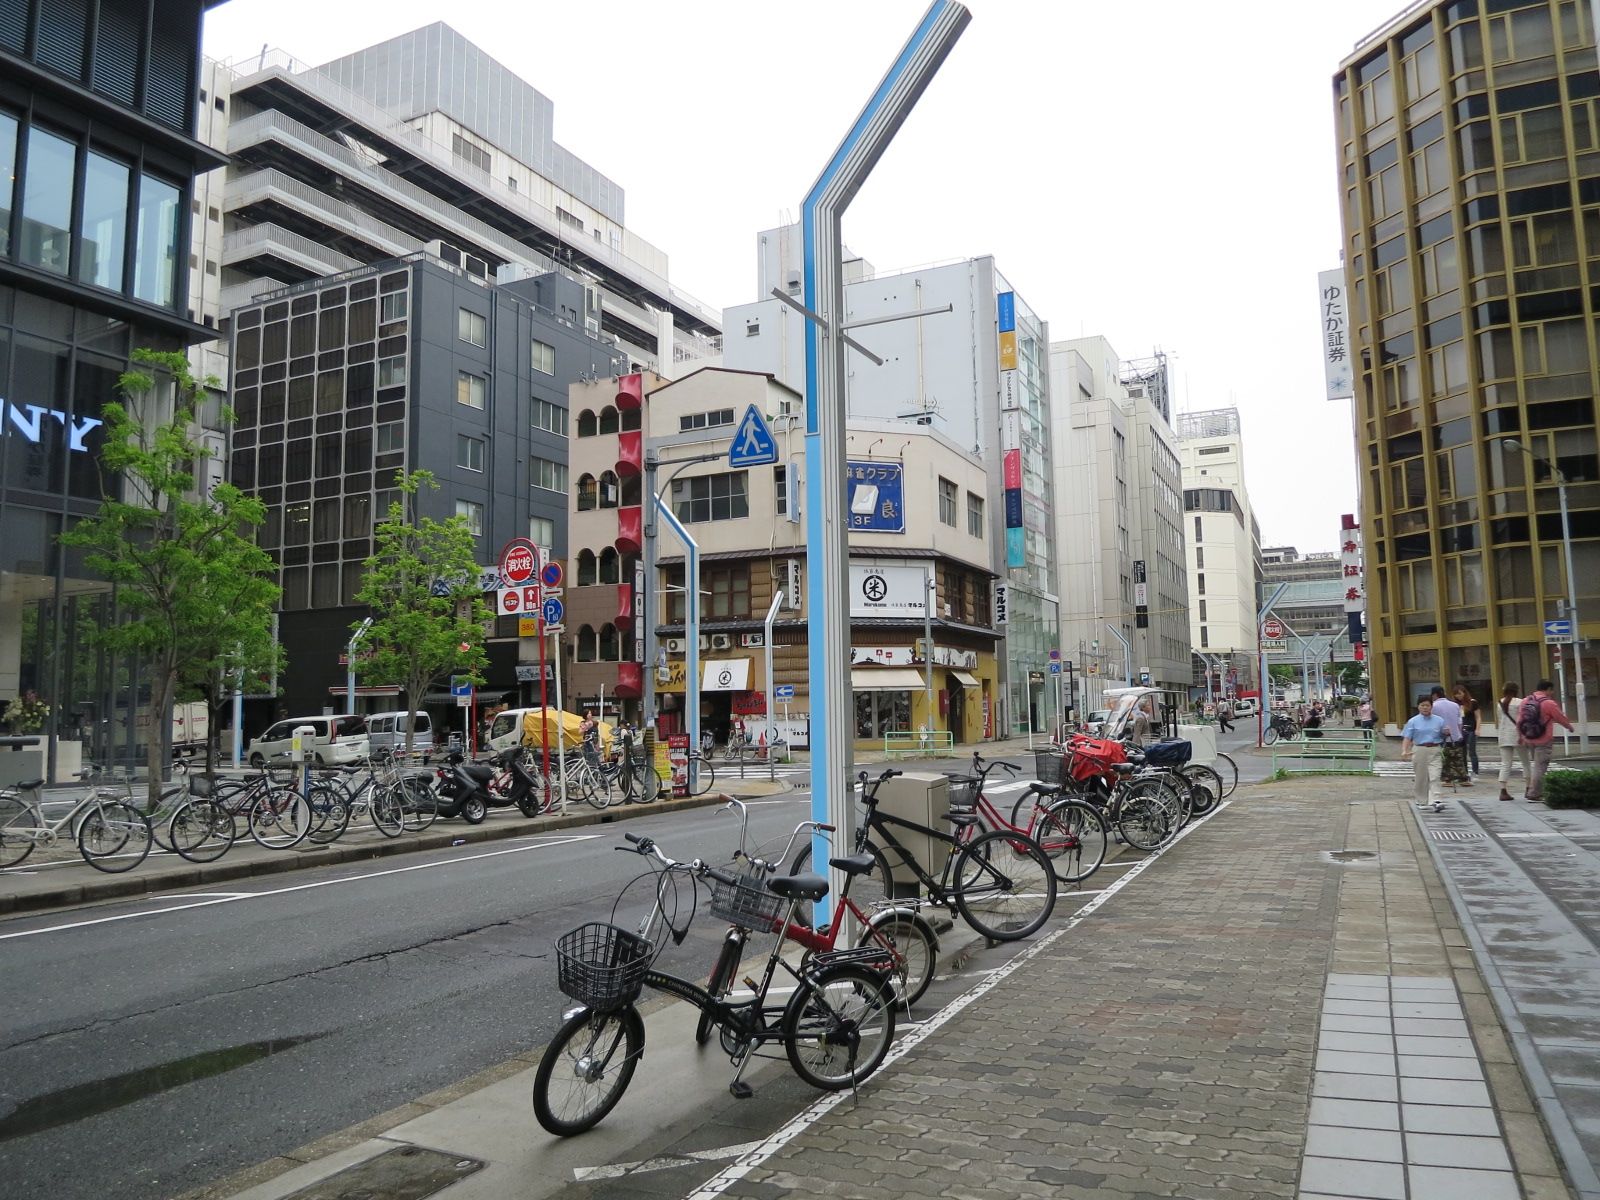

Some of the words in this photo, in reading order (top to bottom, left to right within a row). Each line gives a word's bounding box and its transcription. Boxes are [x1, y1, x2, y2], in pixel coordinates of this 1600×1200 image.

[1324, 286, 1346, 363] ゆたか証券
[0, 398, 103, 452] NY
[854, 516, 871, 525] 3F
[508, 556, 531, 572] 消火栓
[547, 605, 555, 621] P
[996, 587, 1006, 622] マルコメ
